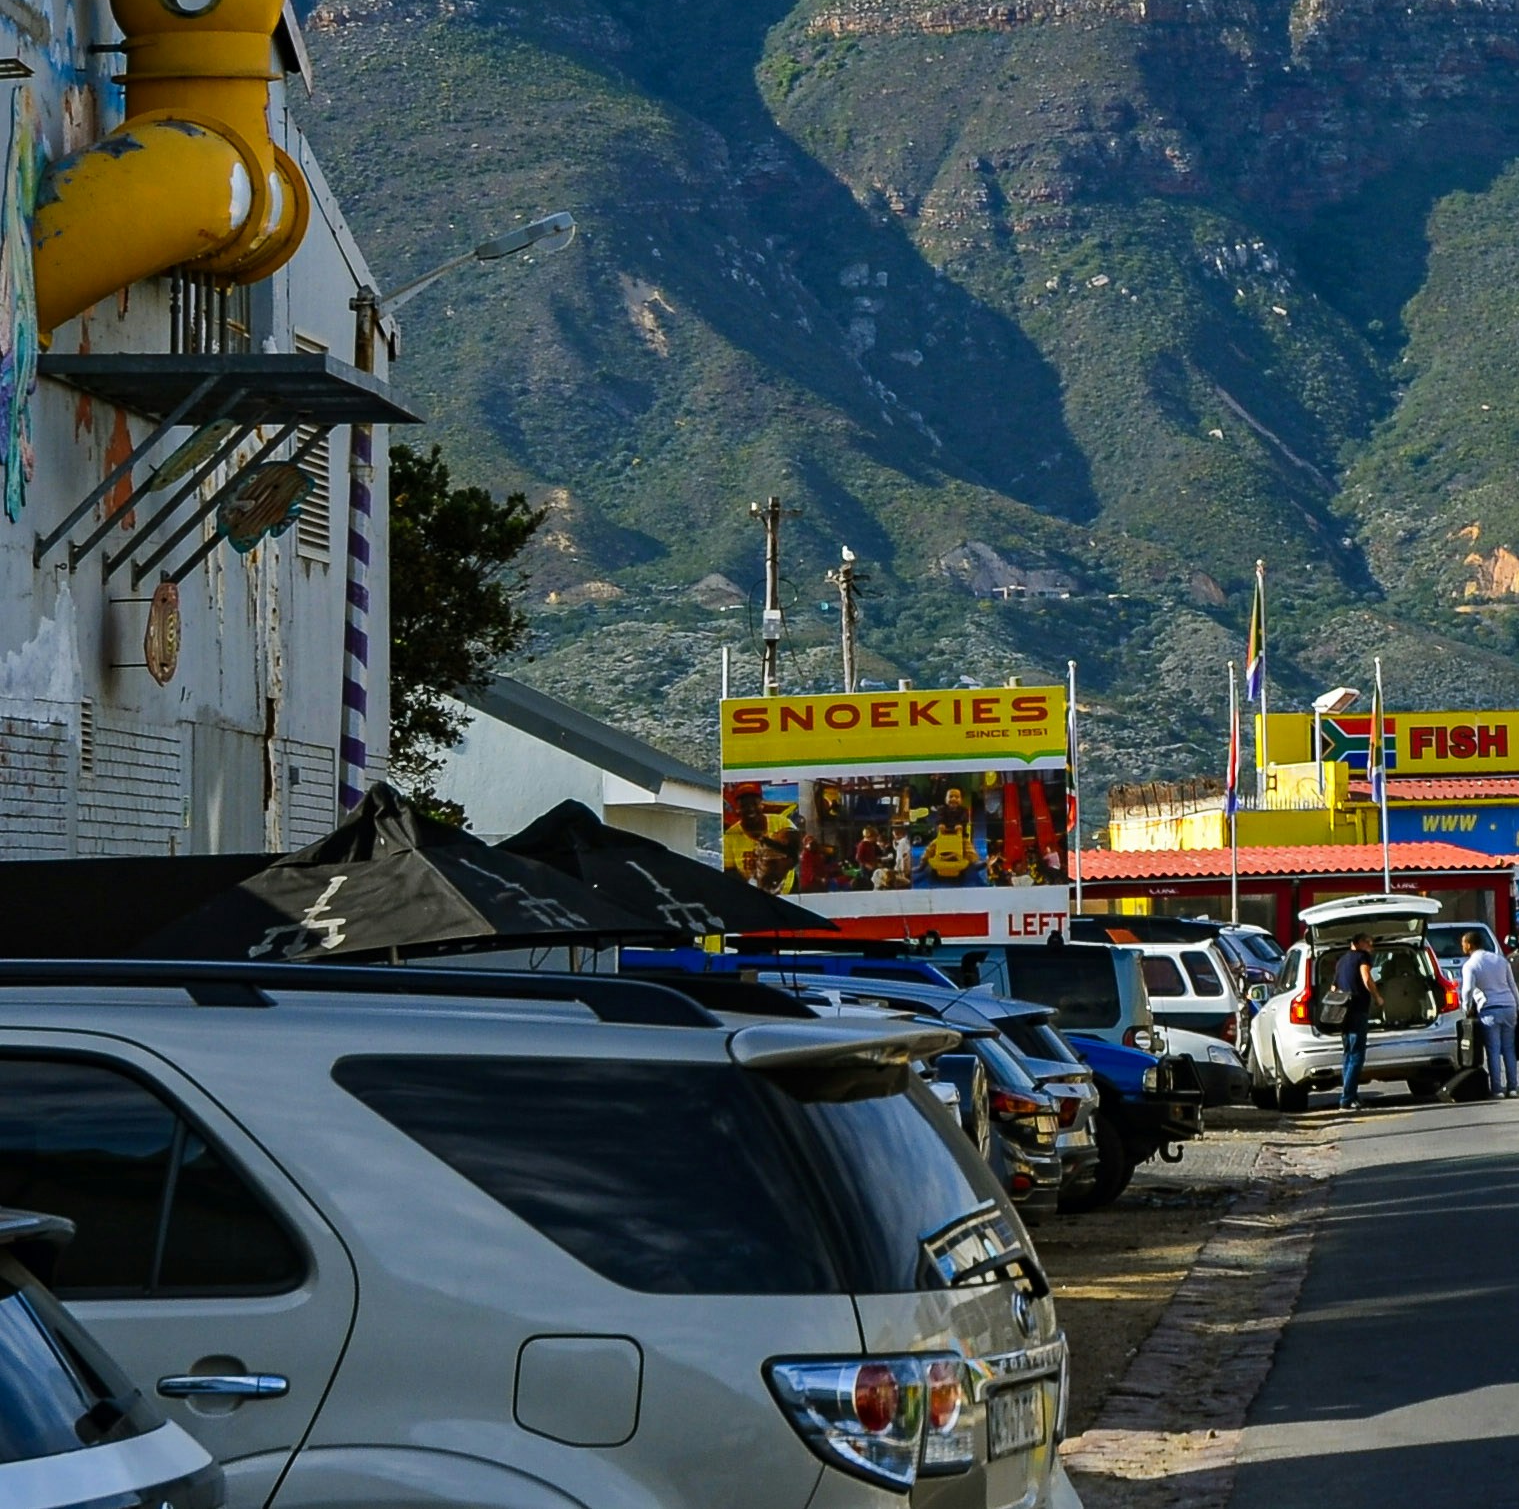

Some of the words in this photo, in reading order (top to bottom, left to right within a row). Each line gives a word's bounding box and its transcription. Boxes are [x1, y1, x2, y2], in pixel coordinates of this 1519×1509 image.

[732, 696, 1048, 734] SNOEKIES
[965, 729, 1010, 739] SINCE
[1017, 728, 1048, 737] 1951
[1409, 725, 1507, 760] FISH
[1008, 912, 1067, 937] LEFT
